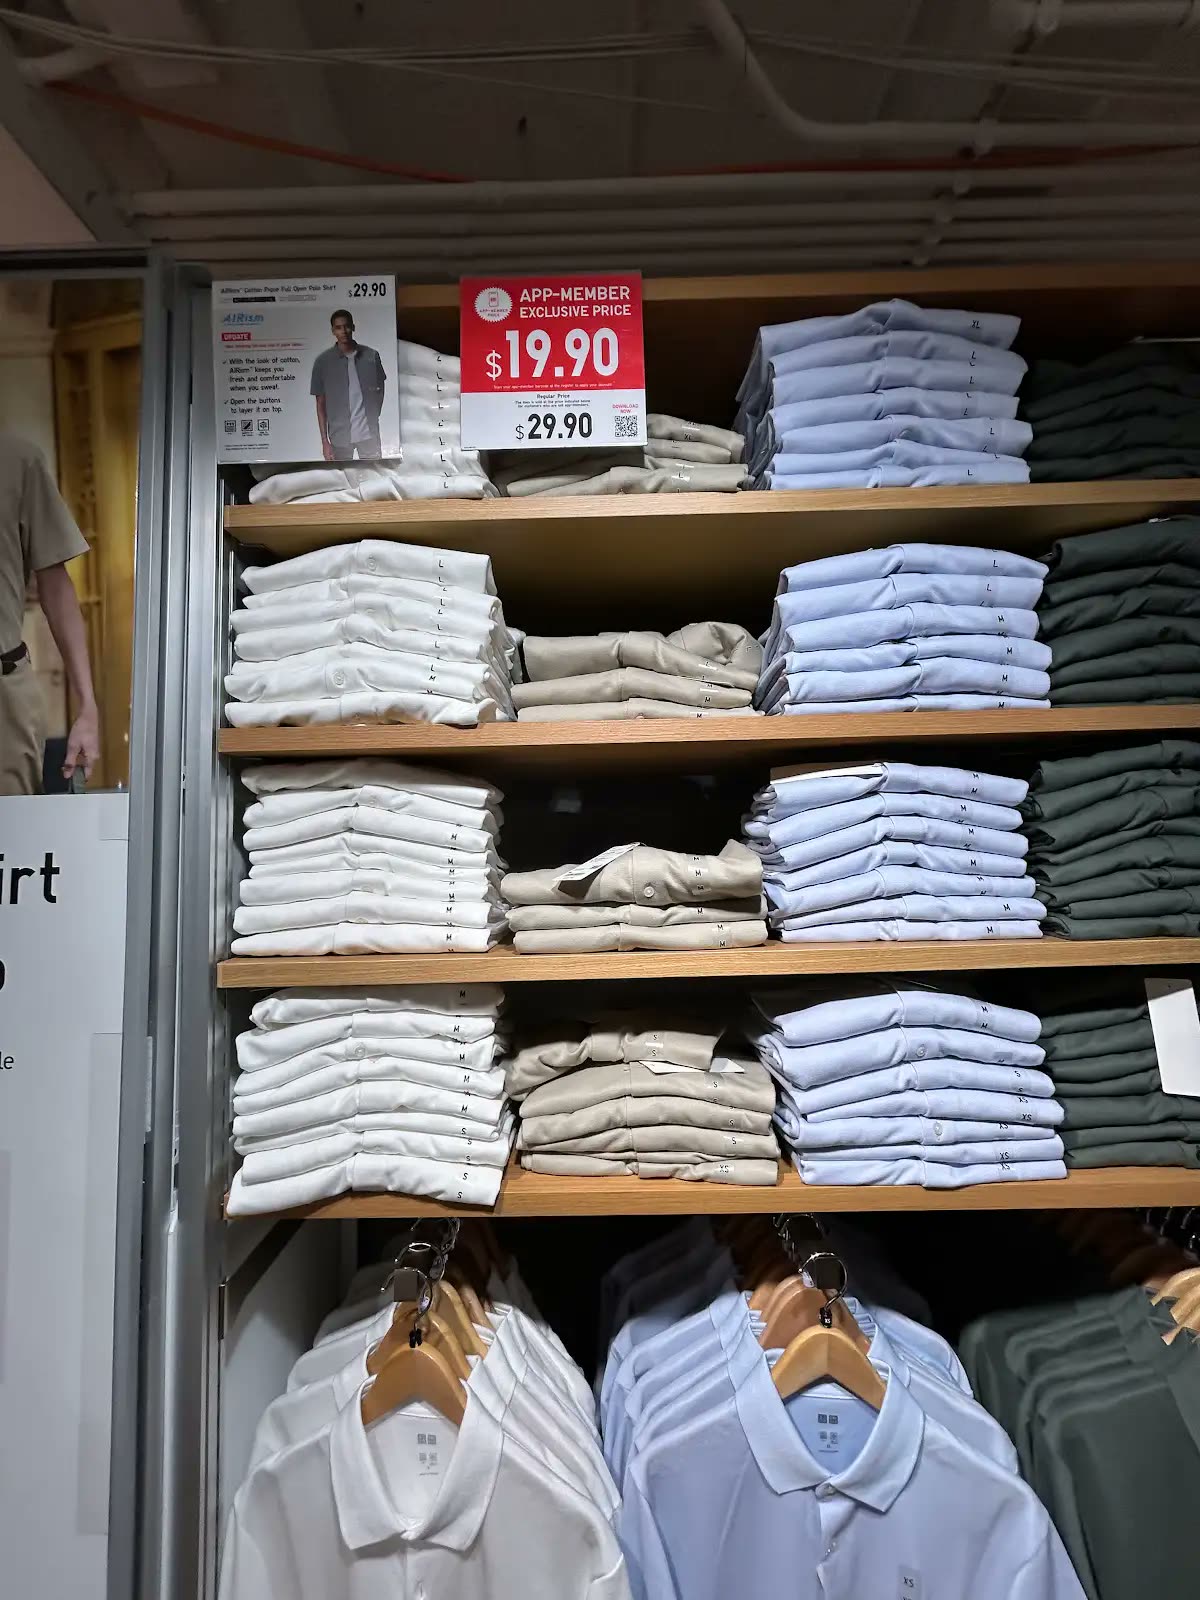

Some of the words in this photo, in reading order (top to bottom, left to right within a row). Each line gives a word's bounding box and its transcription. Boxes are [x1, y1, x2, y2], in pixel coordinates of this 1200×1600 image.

[348, 282, 387, 297] $29.90
[520, 286, 630, 303] APP-MEMBER
[519, 306, 589, 318] EXCLUSIVE
[593, 304, 632, 316] PRICE
[223, 311, 264, 323] AIRism
[971, 320, 980, 328] XL
[485, 328, 619, 381] $19.90
[971, 351, 976, 359] L
[970, 376, 974, 384] L
[515, 412, 592, 441] $29.90
[438, 559, 443, 567] L
[440, 598, 445, 606] L
[1003, 903, 1010, 911] M
[459, 990, 466, 998] M
[981, 1005, 988, 1013] M
[461, 1127, 466, 1135] S
[731, 1137, 736, 1145] S
[999, 1151, 1009, 1159] XS
[719, 1165, 729, 1173] XS
[1000, 1162, 1010, 1170] XS
[462, 1172, 467, 1180] S
[903, 1576, 914, 1588] XS
